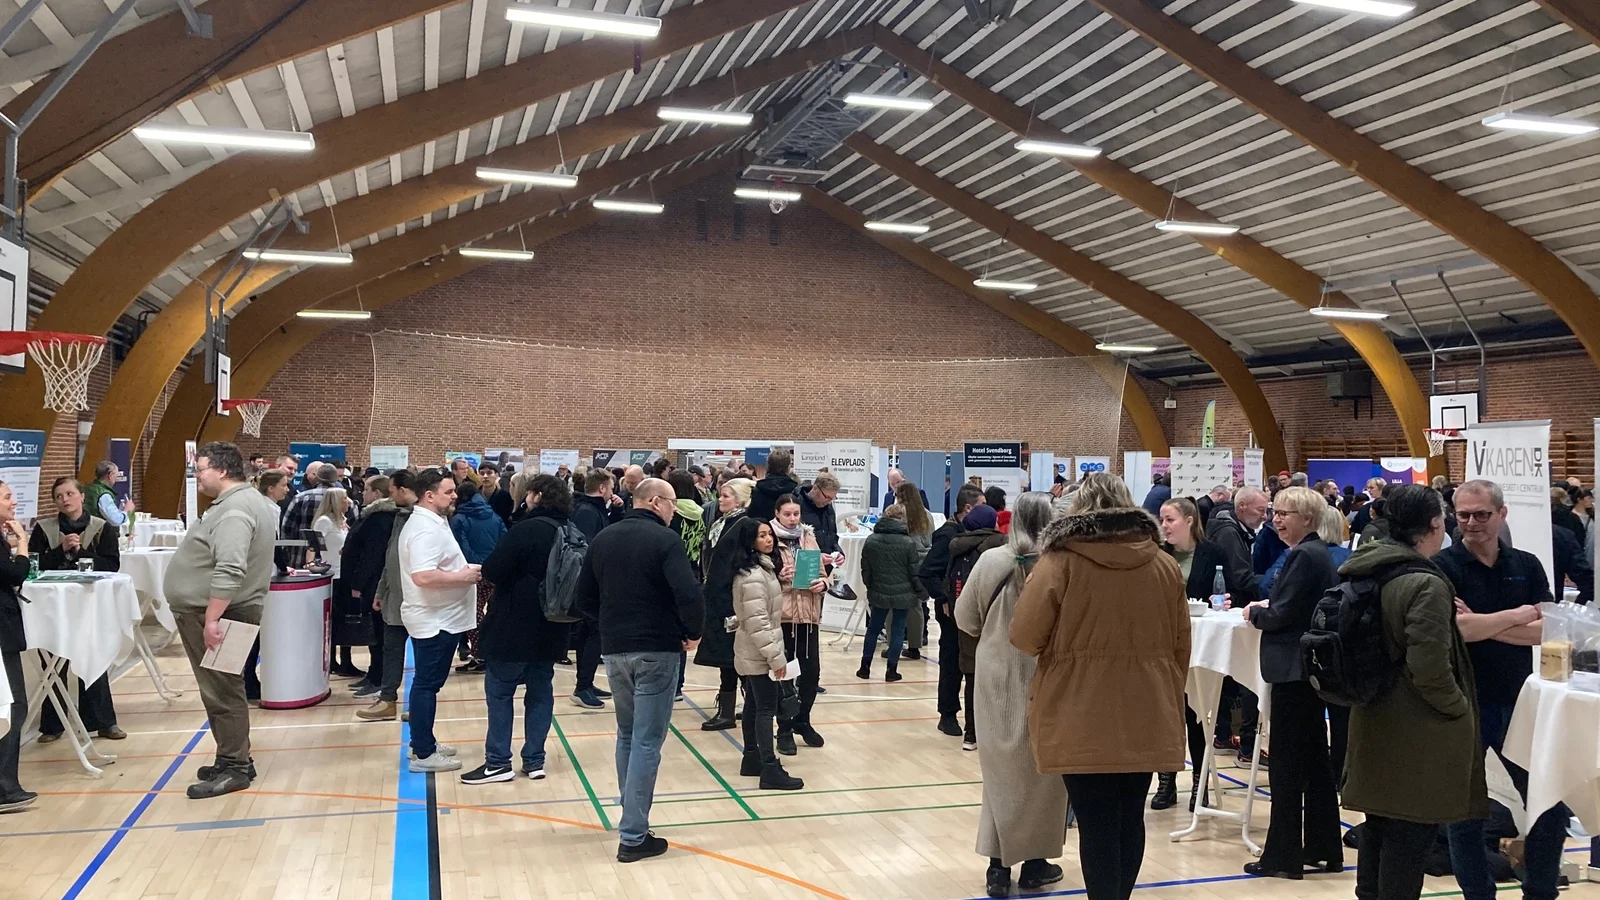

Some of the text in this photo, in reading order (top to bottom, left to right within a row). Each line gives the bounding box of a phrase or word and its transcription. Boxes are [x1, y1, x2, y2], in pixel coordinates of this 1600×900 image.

[986, 447, 1012, 455] Svendborg
[831, 458, 866, 467] ELEVPLADS
[1081, 463, 1104, 471] JKS
